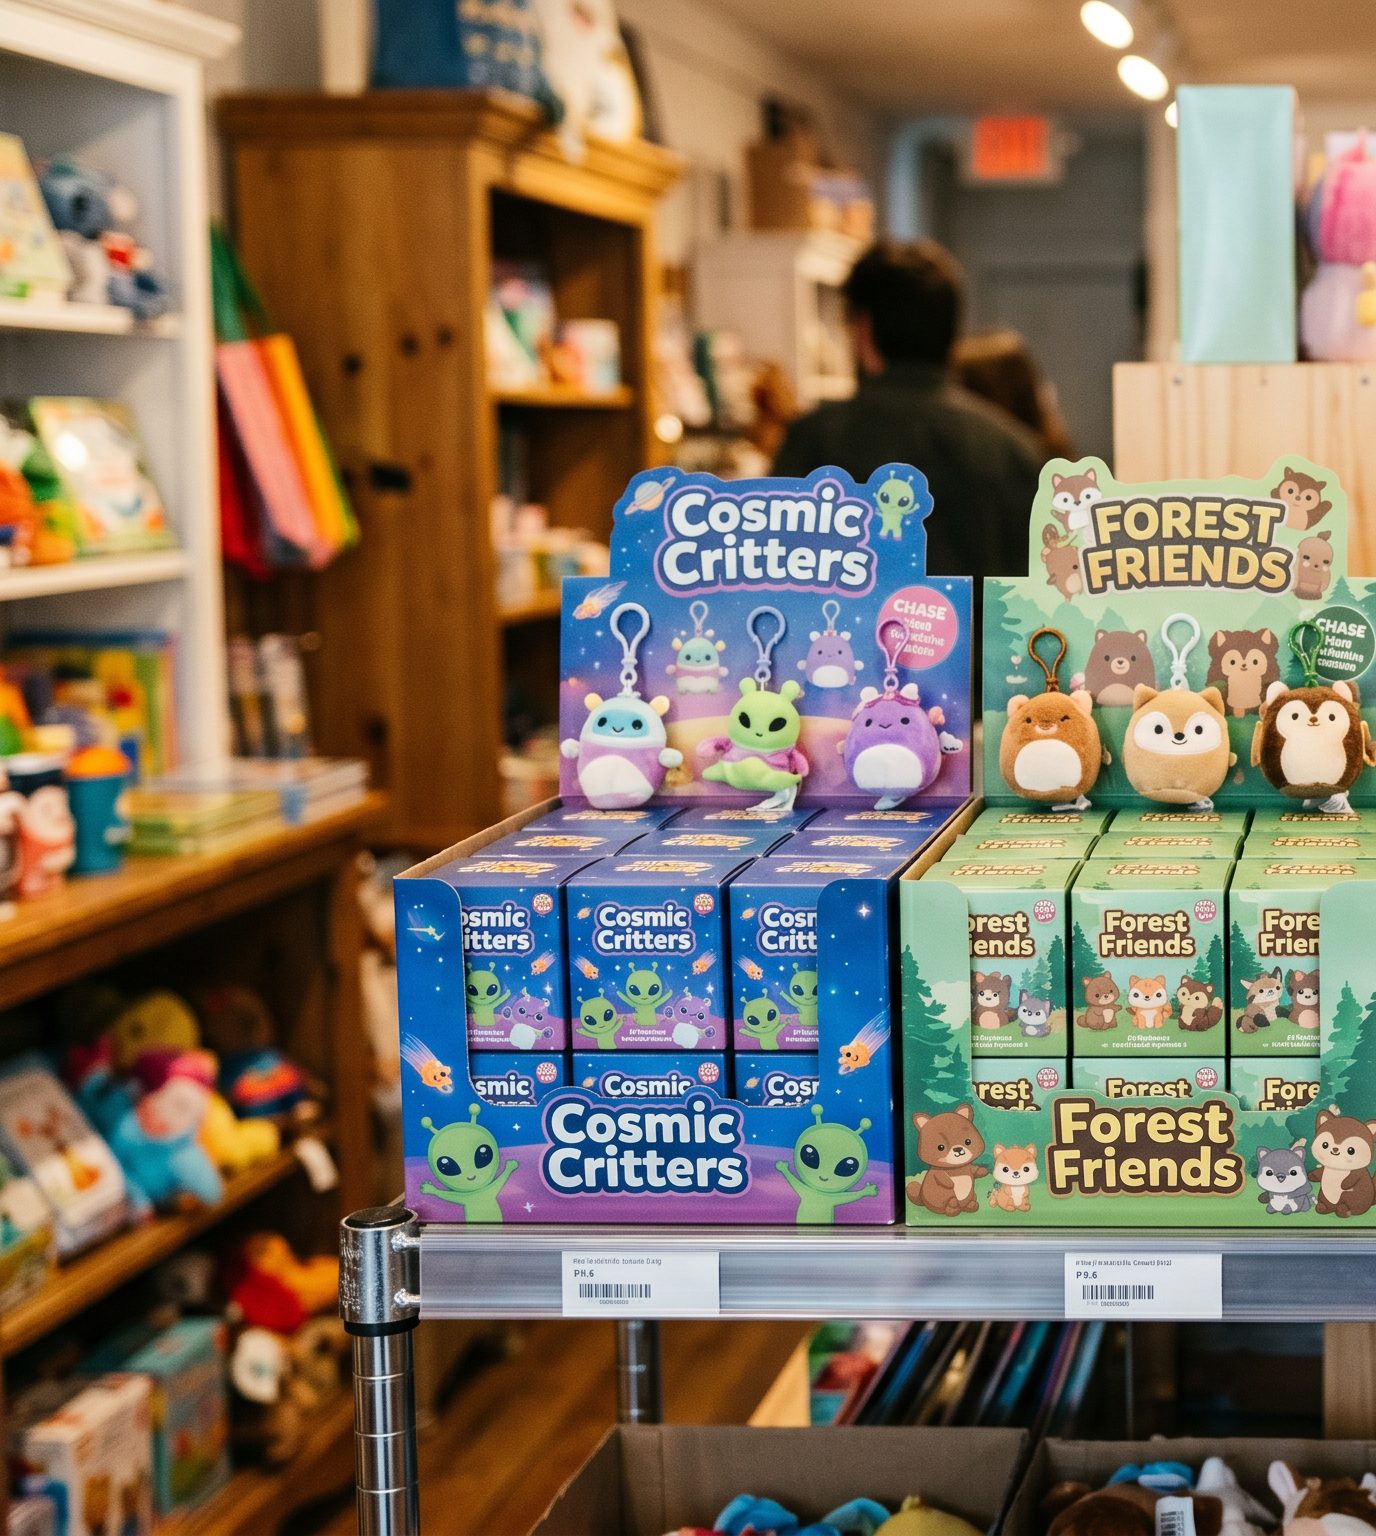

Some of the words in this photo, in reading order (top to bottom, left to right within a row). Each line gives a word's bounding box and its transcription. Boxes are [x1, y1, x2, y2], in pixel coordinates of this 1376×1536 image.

[671, 487, 863, 538] Cosmic
[1095, 501, 1282, 544] FOREST
[662, 533, 870, 587] Critters
[1087, 543, 1290, 590] FRIENDS
[893, 599, 948, 620] CHASE
[1315, 617, 1367, 638] CHASE
[600, 905, 687, 928] Cosmic
[763, 907, 818, 928] Cos
[968, 912, 1029, 933] orest
[1106, 911, 1188, 933] Forest
[1265, 910, 1320, 932] Fore
[463, 928, 530, 950] itters
[597, 928, 692, 950] Critters
[761, 928, 818, 950] Critt
[969, 934, 1034, 955] iends
[1101, 933, 1195, 955] Friends
[1260, 932, 1320, 954] Frien
[474, 1075, 530, 1096] smic
[604, 1075, 692, 1096] Cosmic
[768, 1075, 819, 1097] Cos
[978, 1080, 1031, 1100] rest
[1108, 1079, 1188, 1098] Forest
[1266, 1080, 1320, 1101] Fore
[551, 1100, 735, 1144] Cosmic
[1059, 1103, 1229, 1144] Forest
[548, 1144, 743, 1188] Critters
[1053, 1145, 1238, 1188] Friends
